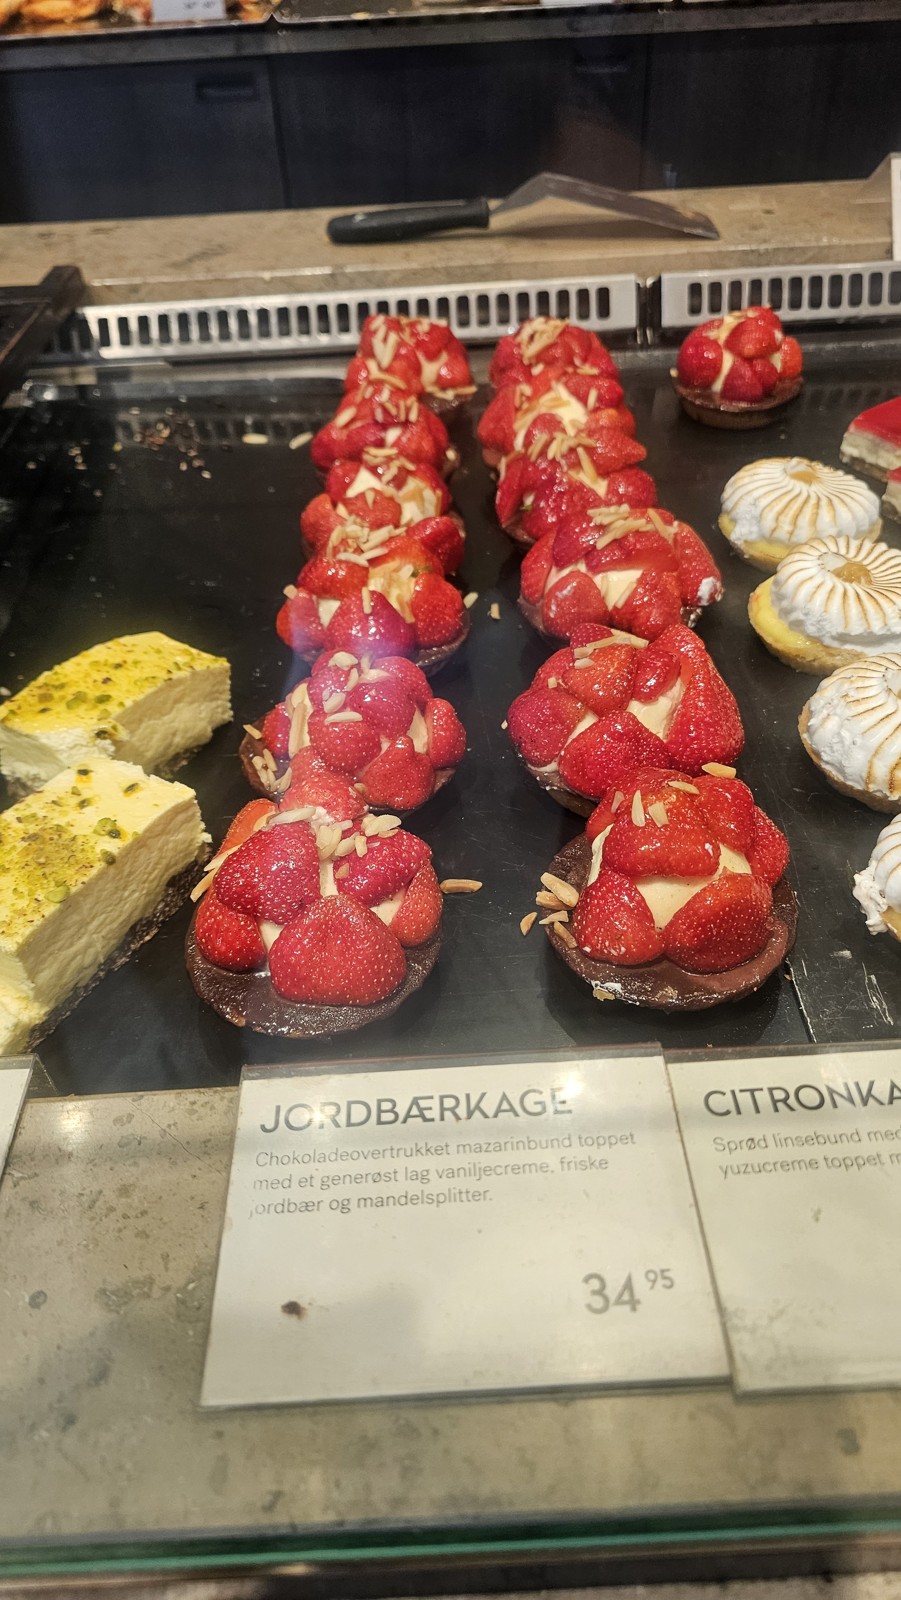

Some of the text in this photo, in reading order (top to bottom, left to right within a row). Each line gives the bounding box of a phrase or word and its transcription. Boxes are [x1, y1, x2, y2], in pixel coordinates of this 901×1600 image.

[259, 1087, 573, 1134] JORDBÆRKAGE
[255, 1131, 637, 1167] Chokoladeovertrukket mazarinbund toppet
[712, 1134, 768, 1155] Sprød
[773, 1129, 862, 1149] linsebund
[253, 1173, 293, 1190] med
[298, 1173, 315, 1188] et
[319, 1168, 399, 1191] generøst
[404, 1166, 431, 1184] lag
[559, 1155, 609, 1172] friske
[719, 1159, 820, 1180] yuzucreme
[823, 1151, 885, 1171] toppet
[328, 1198, 352, 1214] og
[356, 1187, 493, 1209] mandelsplitter.
